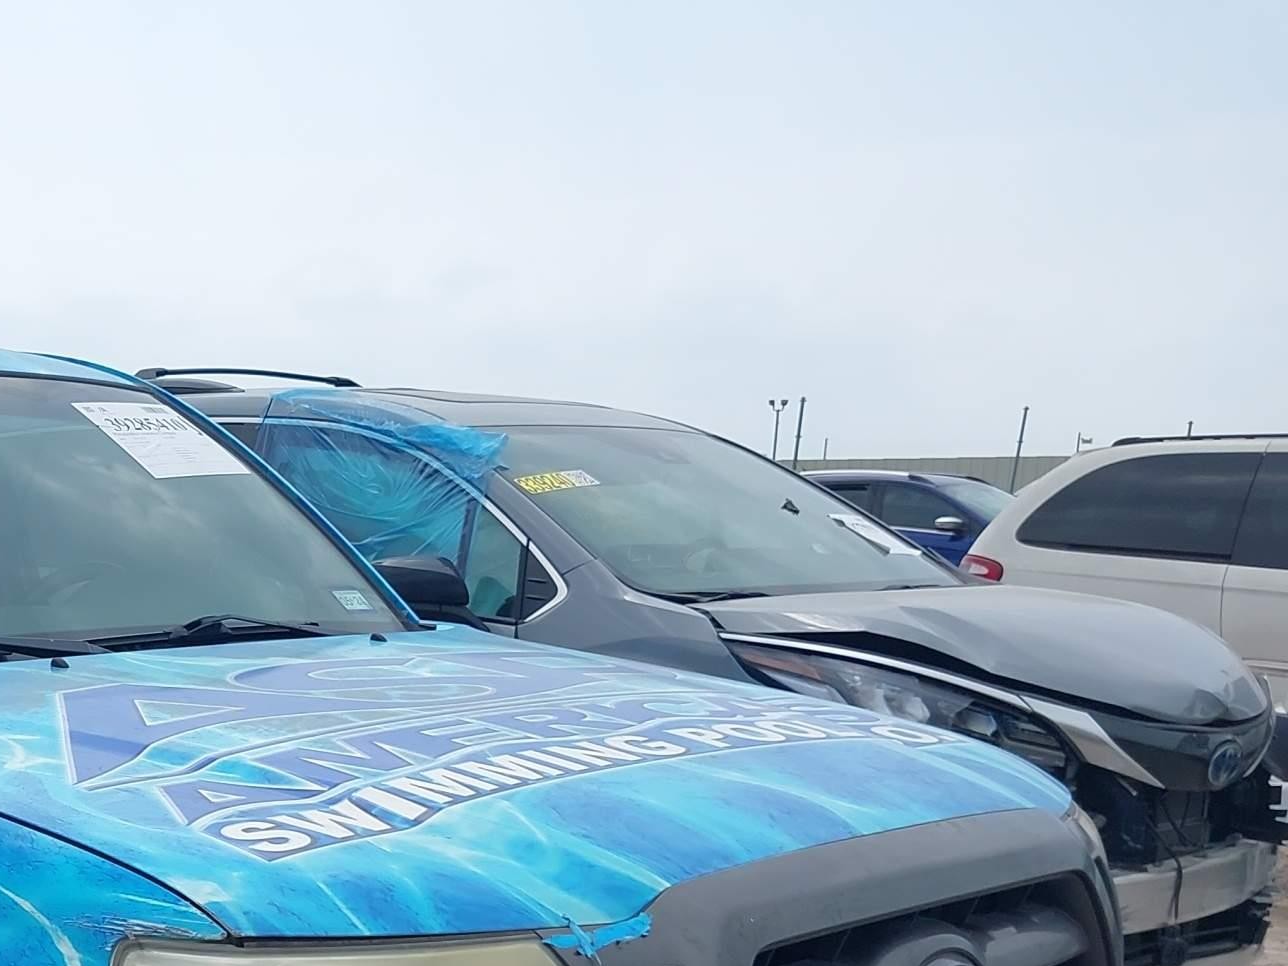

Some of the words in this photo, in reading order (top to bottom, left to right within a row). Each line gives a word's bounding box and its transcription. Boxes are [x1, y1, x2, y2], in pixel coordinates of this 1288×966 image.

[103, 417, 188, 432] 39285410
[220, 734, 688, 852] SWIMMING
[676, 720, 866, 749] POOL
